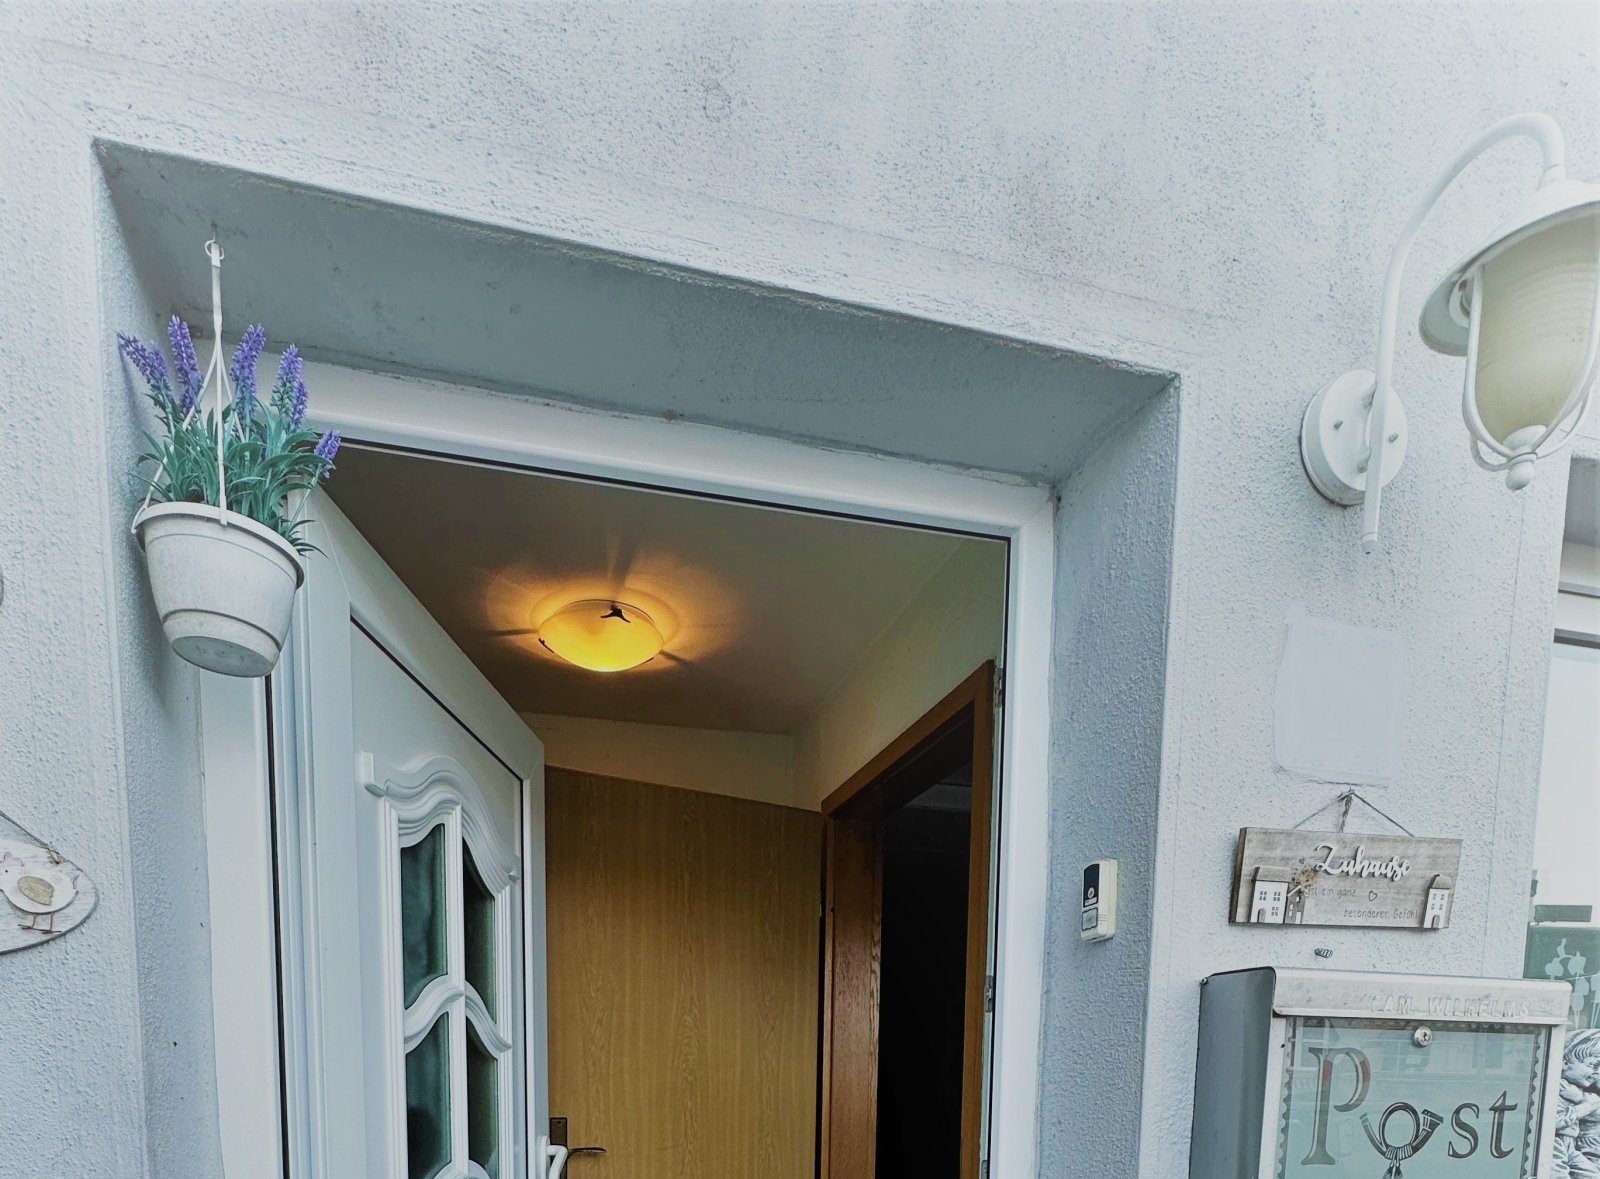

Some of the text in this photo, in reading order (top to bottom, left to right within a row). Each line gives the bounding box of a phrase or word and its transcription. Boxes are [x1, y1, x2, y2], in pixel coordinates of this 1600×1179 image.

[1314, 842, 1411, 881] Zuhause
[1322, 887, 1335, 897] ein
[1343, 908, 1389, 919] besonderes
